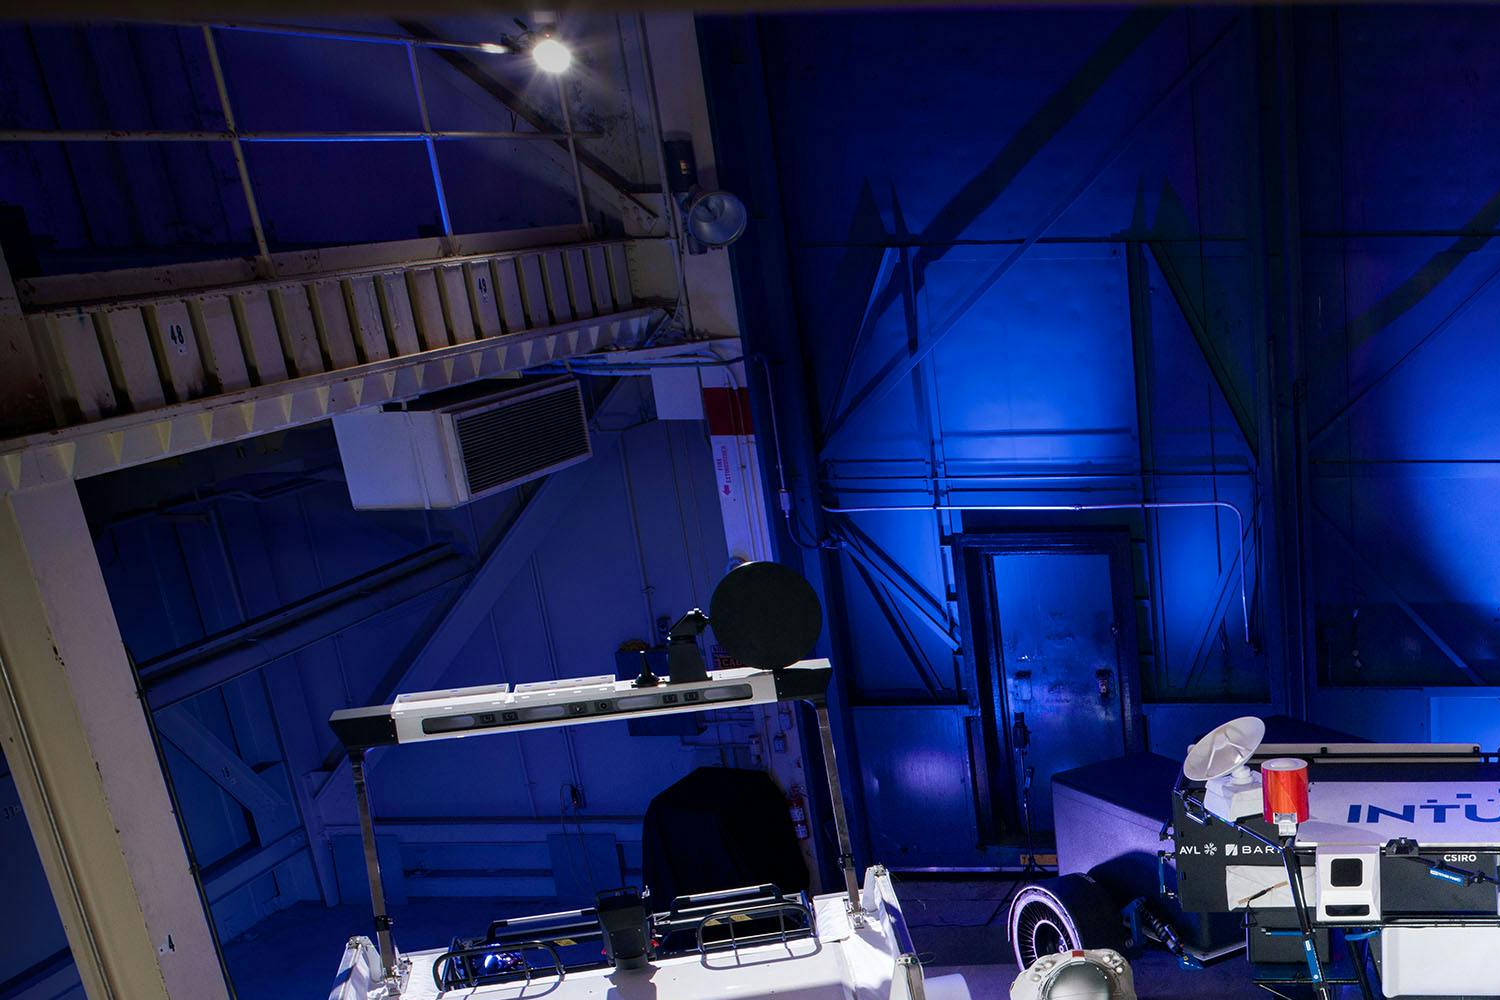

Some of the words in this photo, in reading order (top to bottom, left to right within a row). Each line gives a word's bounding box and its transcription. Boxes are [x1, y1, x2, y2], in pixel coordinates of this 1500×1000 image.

[170, 324, 184, 345] 48
[1179, 845, 1201, 855] AVL
[1443, 854, 1477, 862] CSIRO
